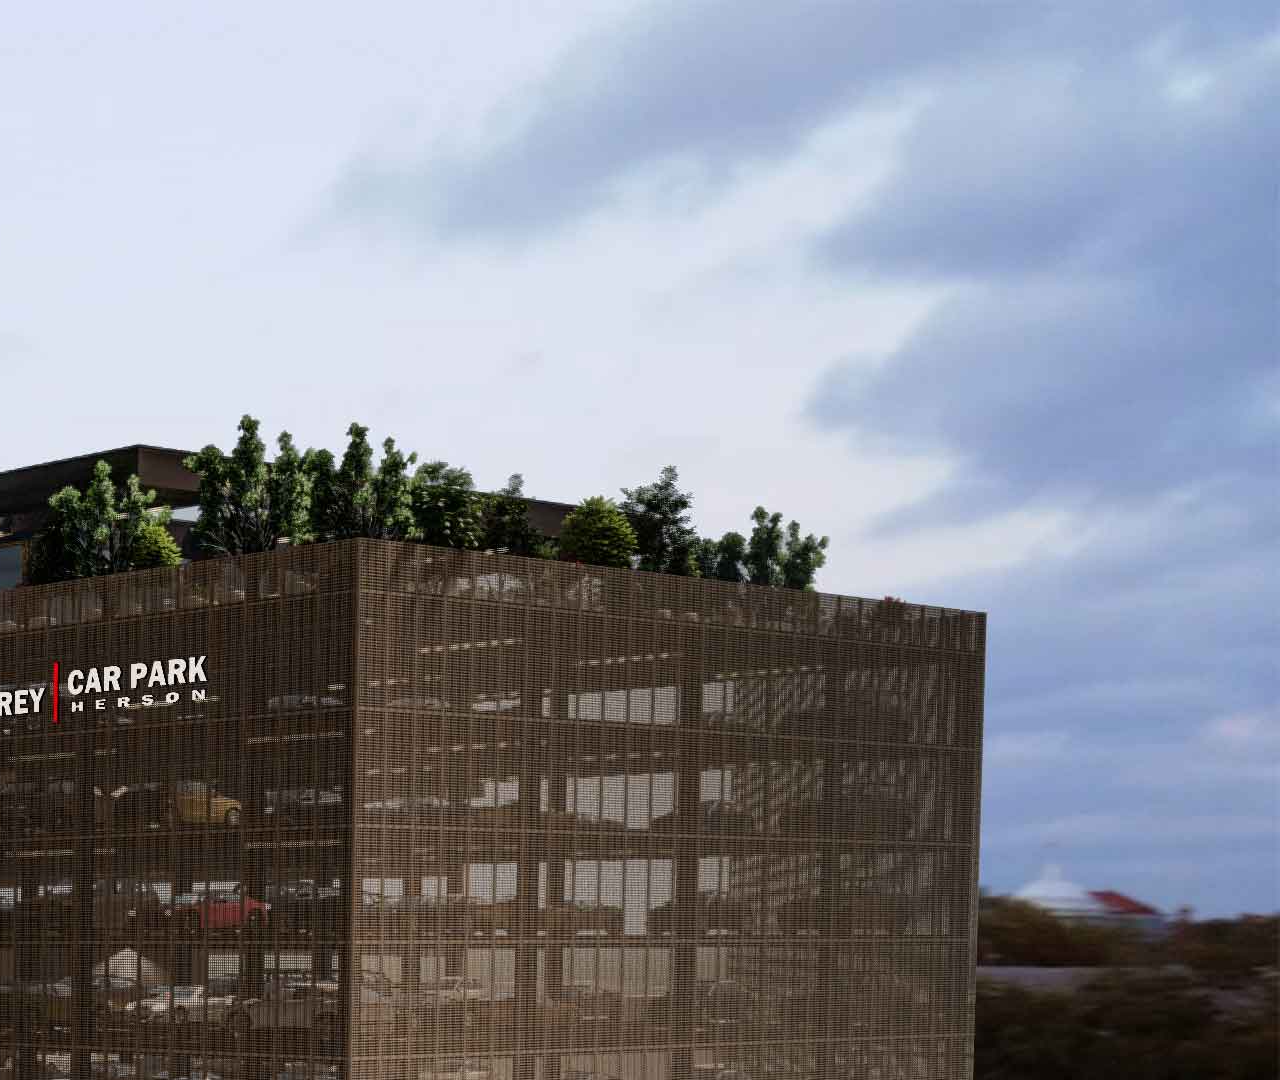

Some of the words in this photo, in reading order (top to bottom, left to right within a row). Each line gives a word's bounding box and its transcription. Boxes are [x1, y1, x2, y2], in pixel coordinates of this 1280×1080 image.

[67, 665, 122, 696] CAR
[130, 655, 208, 689] PARK
[71, 689, 207, 713] HERSON
